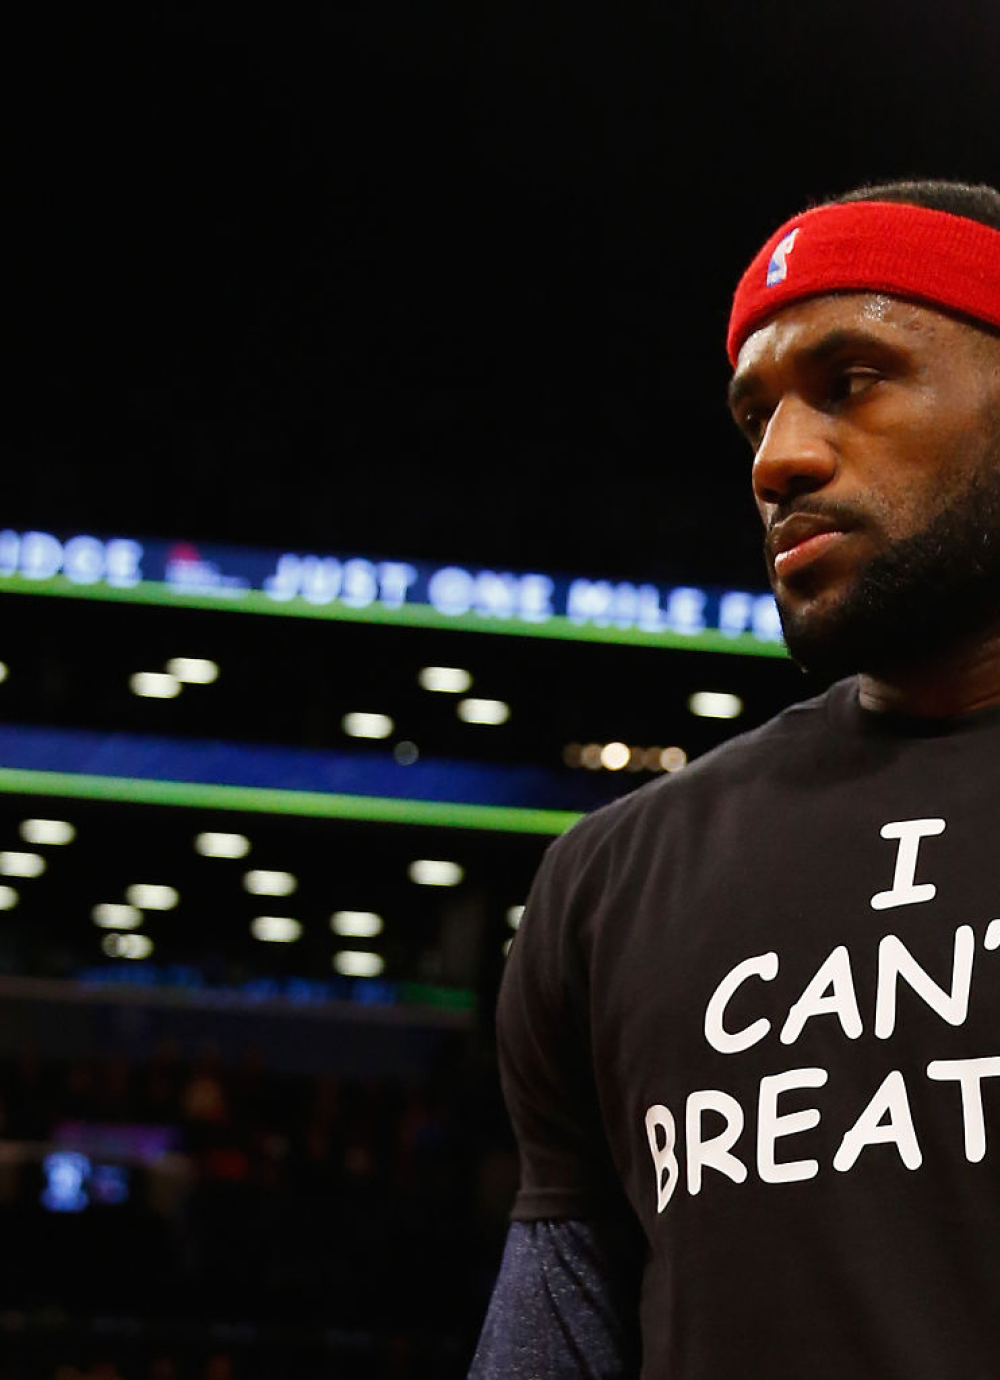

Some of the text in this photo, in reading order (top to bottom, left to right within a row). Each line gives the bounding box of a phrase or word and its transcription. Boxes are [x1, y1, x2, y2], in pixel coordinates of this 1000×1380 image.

[263, 553, 418, 609] JUST
[428, 566, 555, 623] ONE
[567, 578, 706, 636] MILE
[870, 818, 946, 910] I
